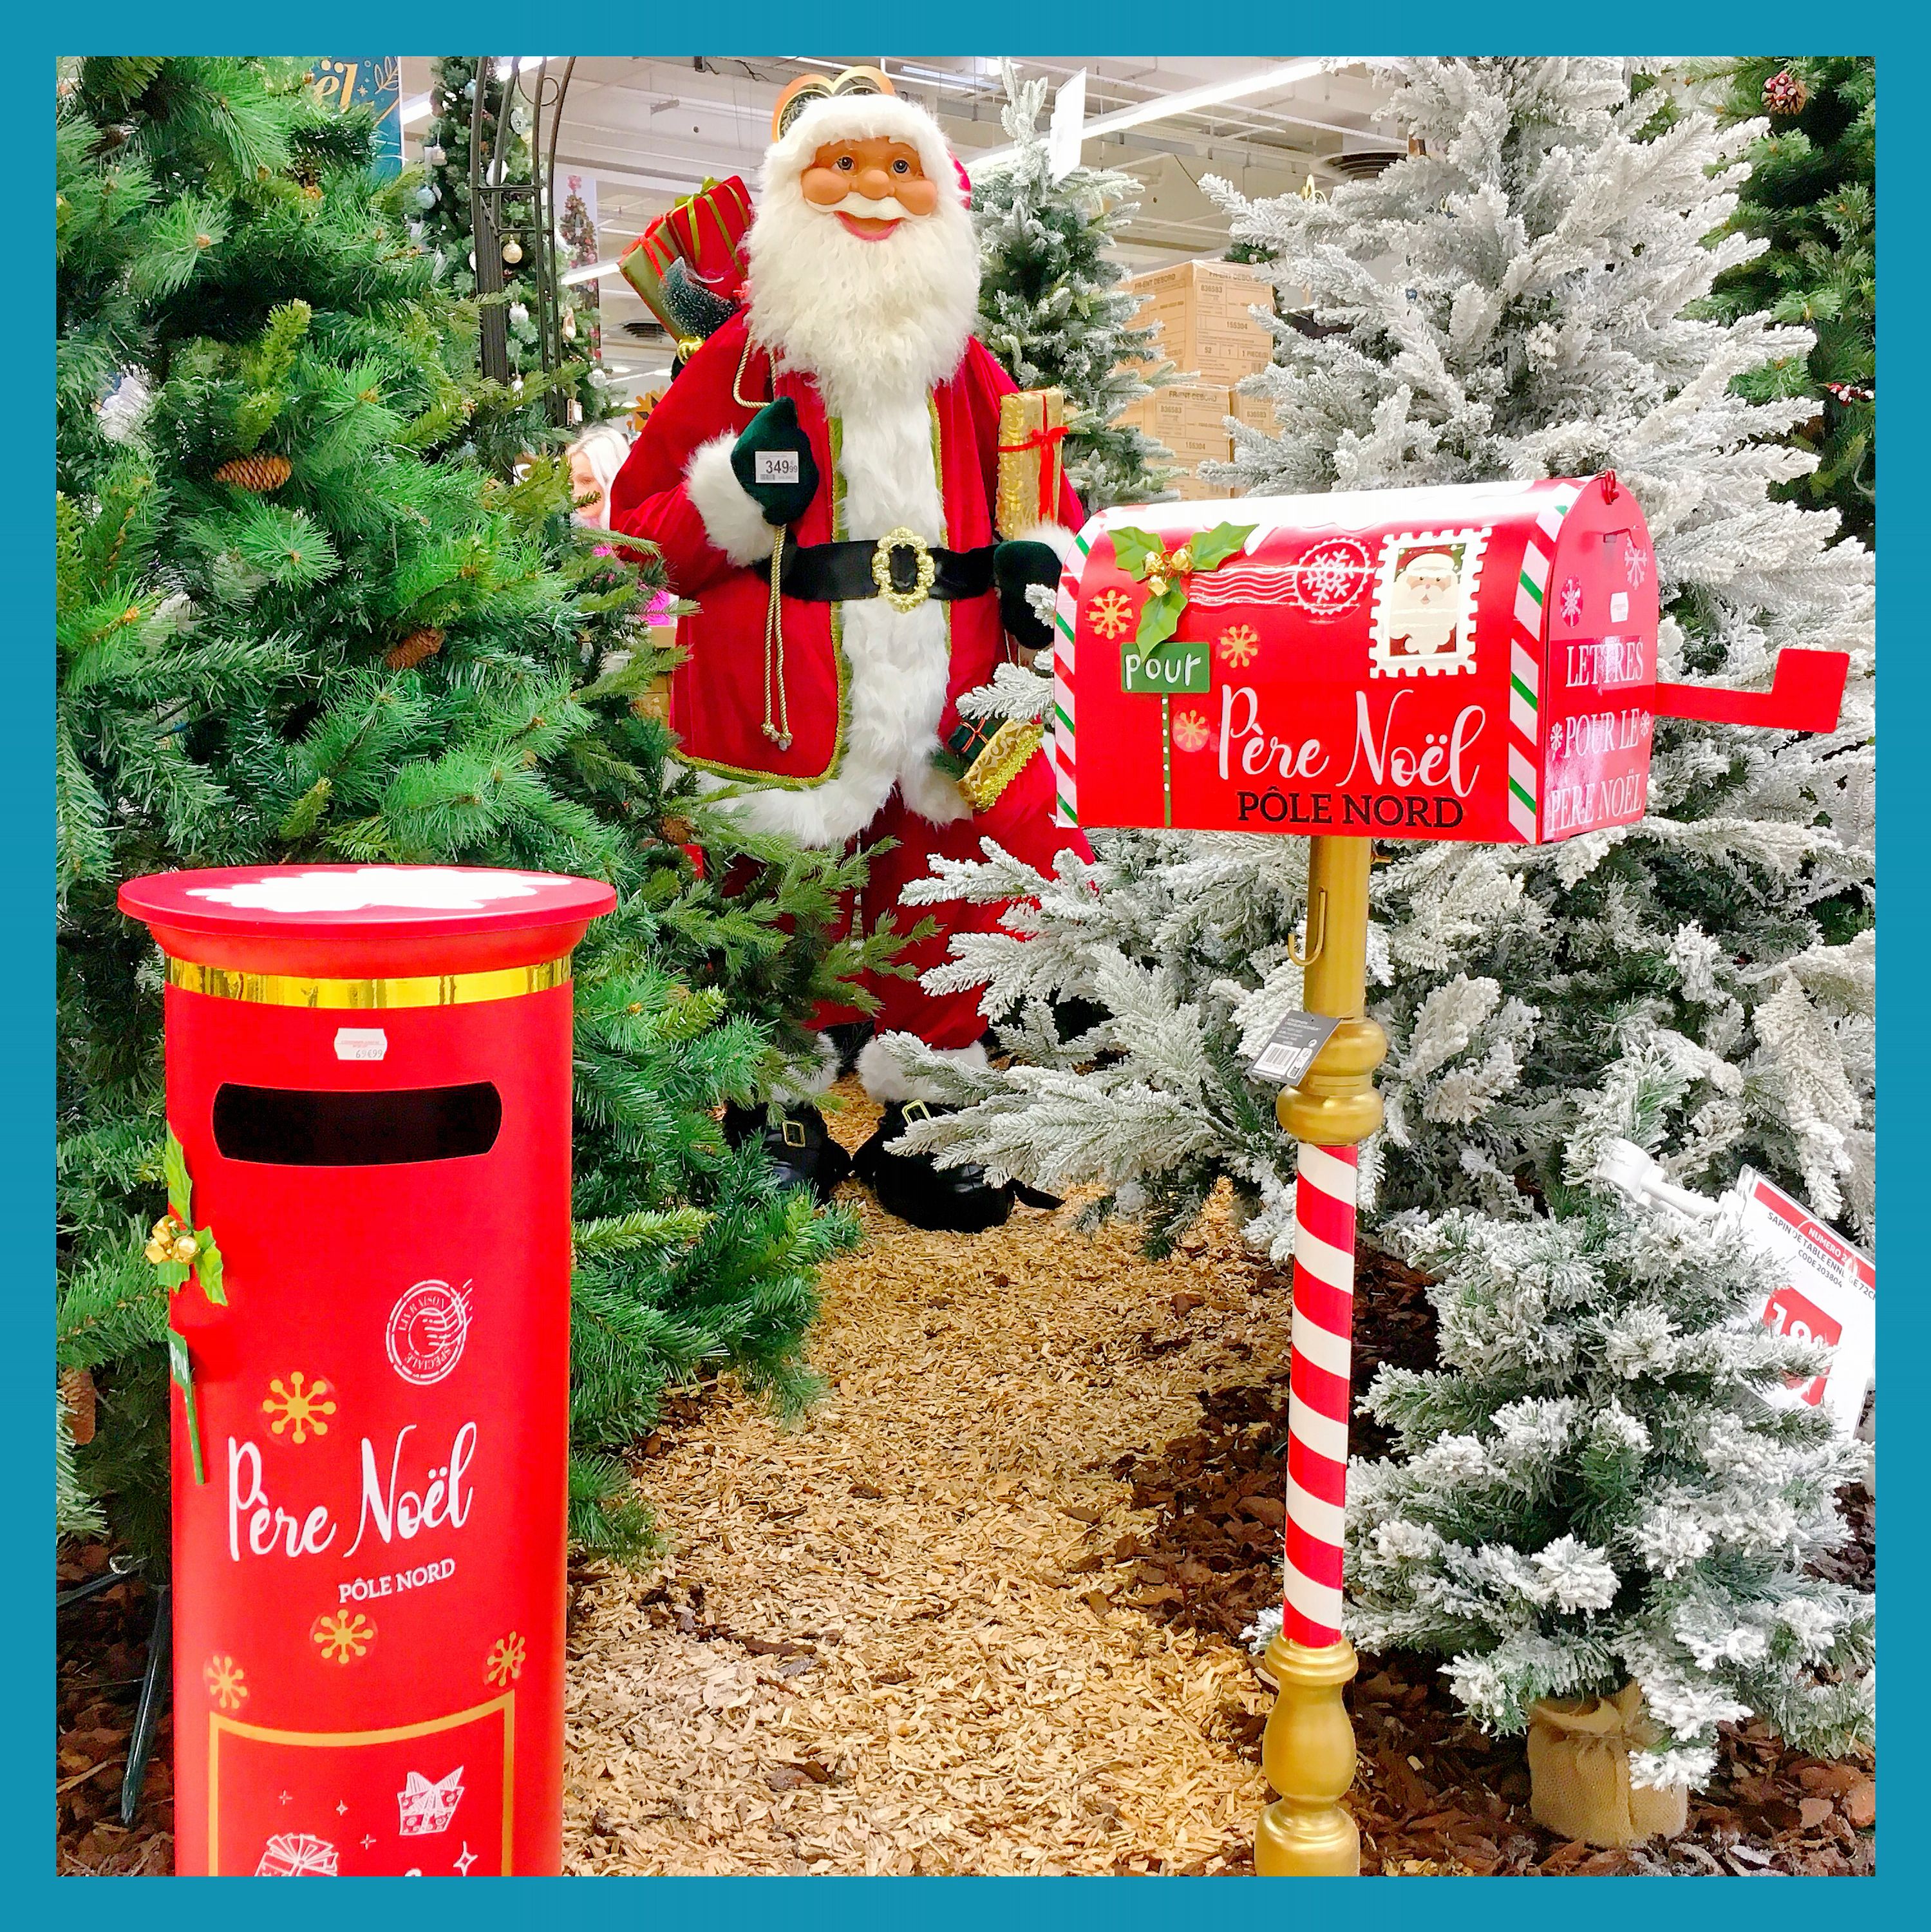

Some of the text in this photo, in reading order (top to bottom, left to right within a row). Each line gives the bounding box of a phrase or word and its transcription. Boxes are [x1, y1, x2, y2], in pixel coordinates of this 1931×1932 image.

[1226, 321, 1248, 330] 155304
[1204, 345, 1212, 354] 52
[1125, 650, 1202, 690] pour
[1565, 640, 1644, 688] LETTRES
[1220, 685, 1486, 798] Père Noël
[1563, 708, 1640, 759] POUR LE
[1237, 785, 1464, 829] PÔLE NORD
[1597, 768, 1641, 821] NOËL
[1767, 1212, 1792, 1235] SAPIN
[1802, 1239, 1826, 1263] TABLE
[1807, 1227, 1842, 1257] NUMERO
[1798, 1249, 1843, 1289] CODE 203804
[227, 1421, 477, 1562] Père Noël
[337, 1557, 456, 1604] PÔLE NORD
